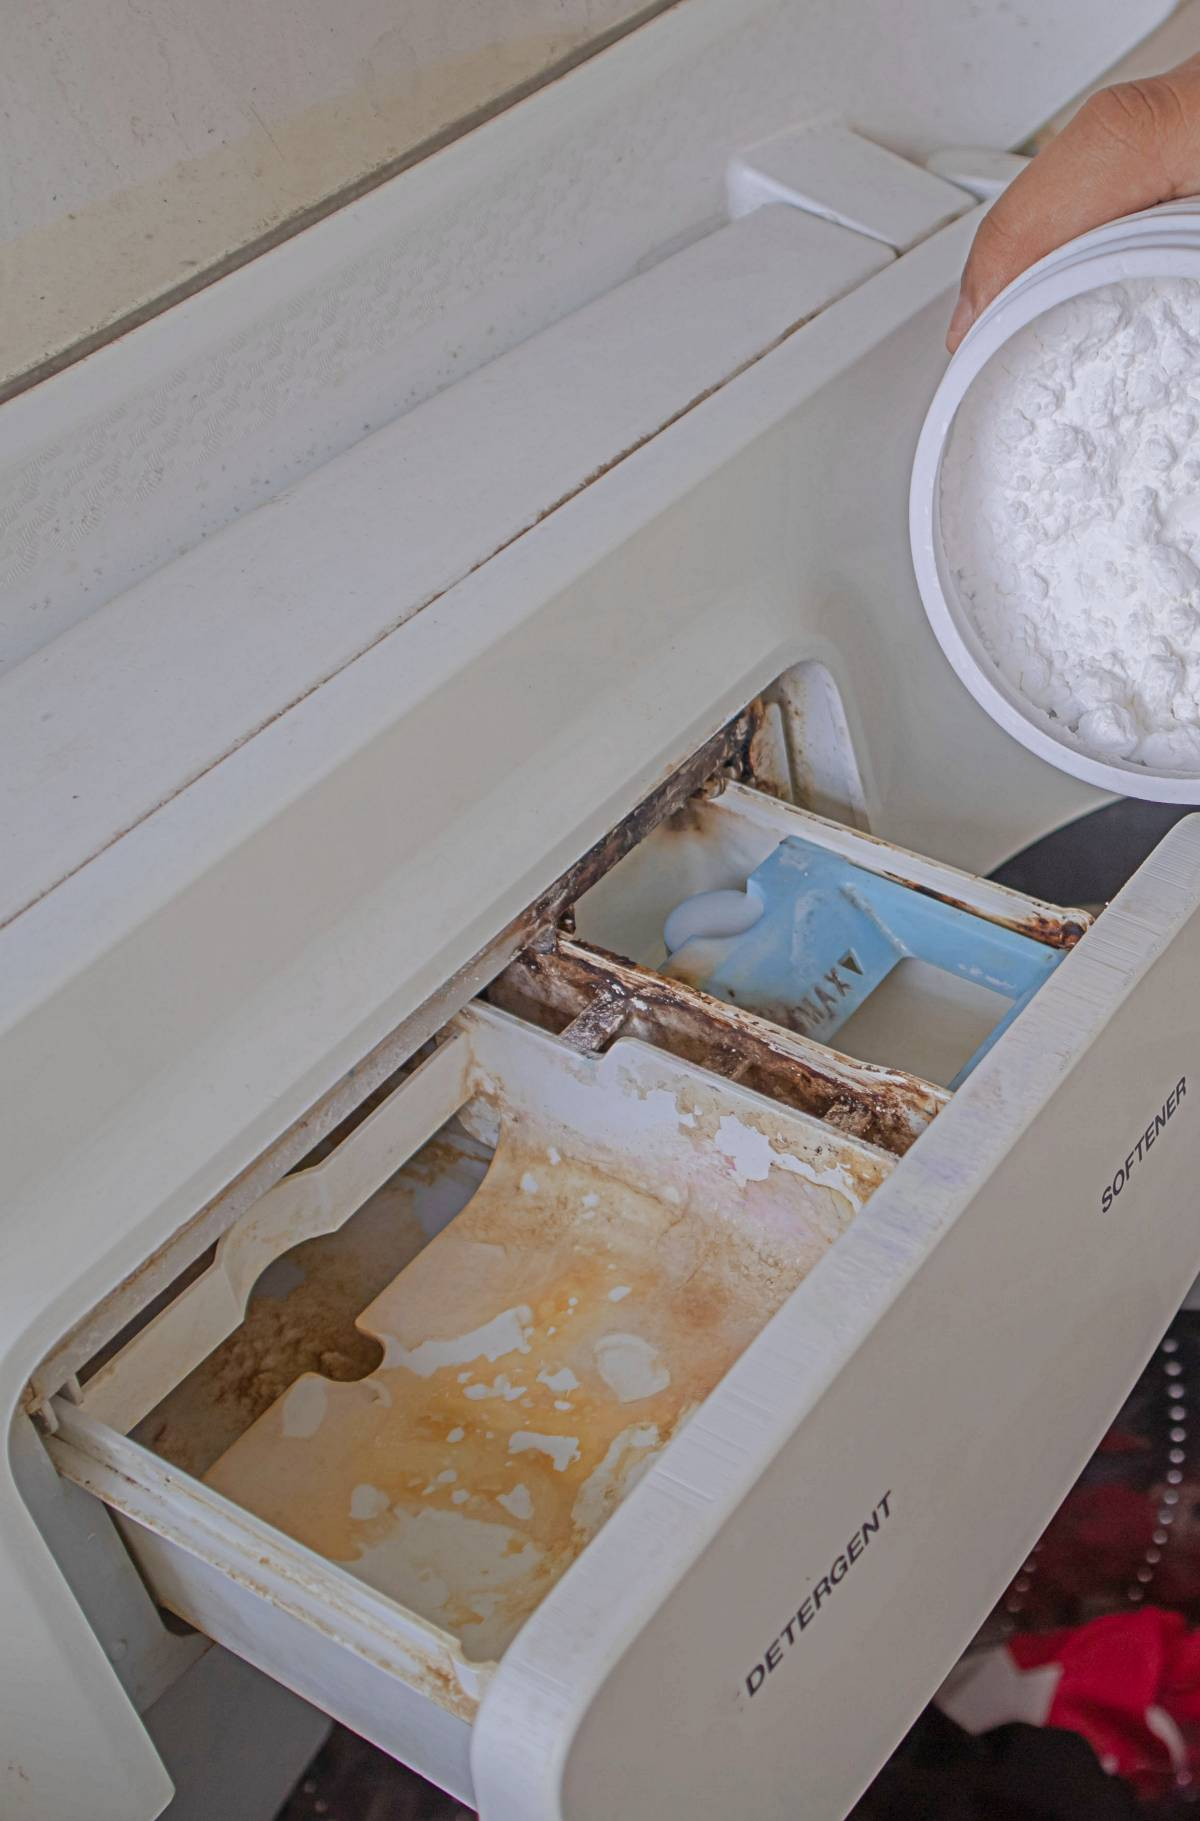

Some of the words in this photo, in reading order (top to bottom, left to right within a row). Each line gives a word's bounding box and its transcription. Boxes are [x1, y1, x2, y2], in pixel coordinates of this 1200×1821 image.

[792, 967, 851, 1028] MAX
[1101, 1076, 1187, 1213] SOFTENER
[745, 1490, 892, 1697] DETERGENT
